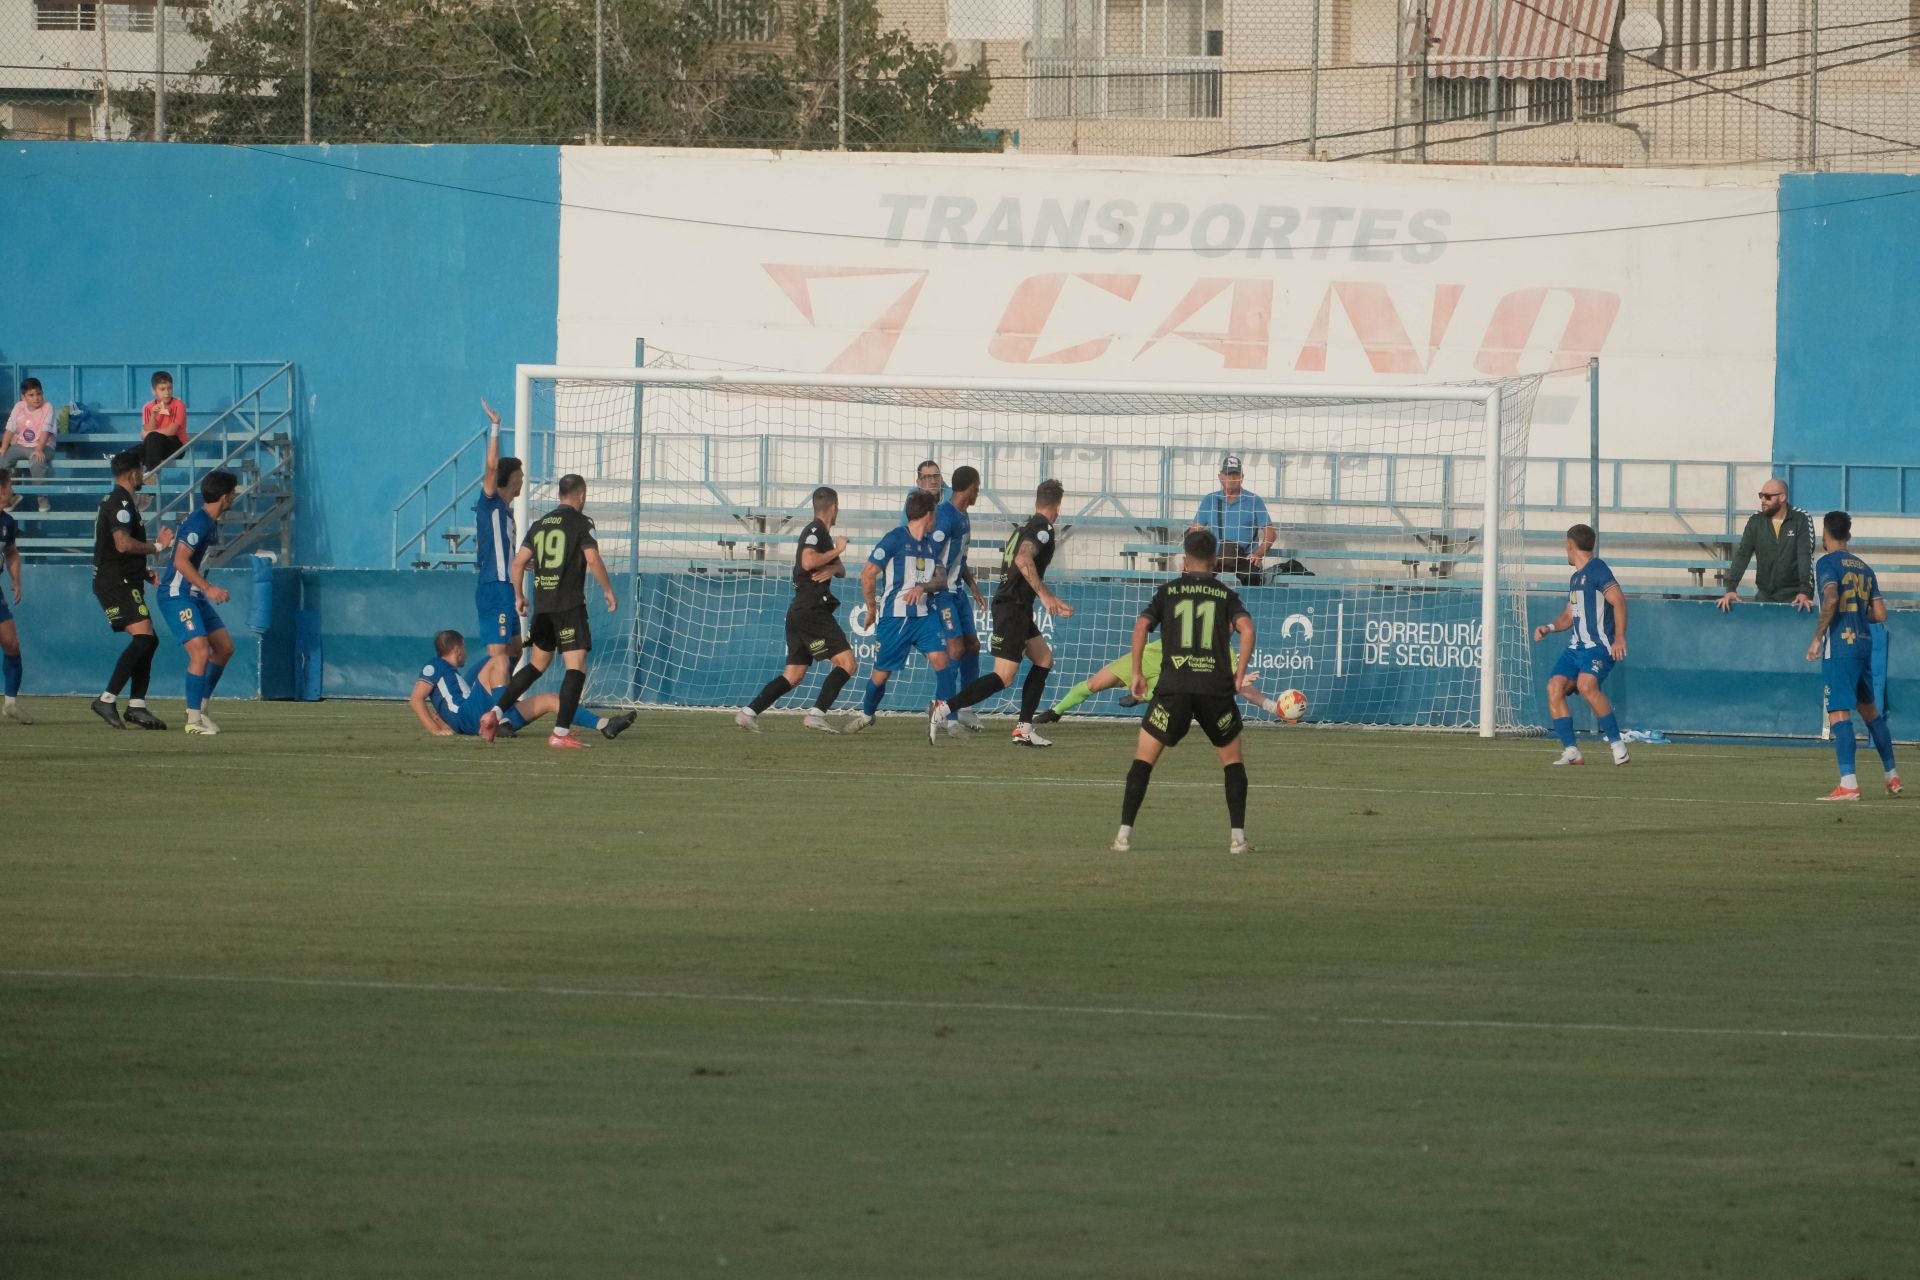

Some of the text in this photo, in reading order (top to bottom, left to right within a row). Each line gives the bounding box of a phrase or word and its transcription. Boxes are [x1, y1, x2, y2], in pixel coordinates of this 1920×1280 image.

[878, 193, 1452, 265] TRANSPORTES
[987, 271, 1622, 379] CANO
[533, 528, 566, 569] 19
[1167, 585, 1179, 595] M.
[1839, 572, 1872, 612] 24
[180, 608, 193, 622] 20
[499, 613, 507, 624] 6
[1174, 598, 1216, 650] 11
[1237, 648, 1313, 670] diación
[1364, 643, 1483, 669] DE SEGUROS
